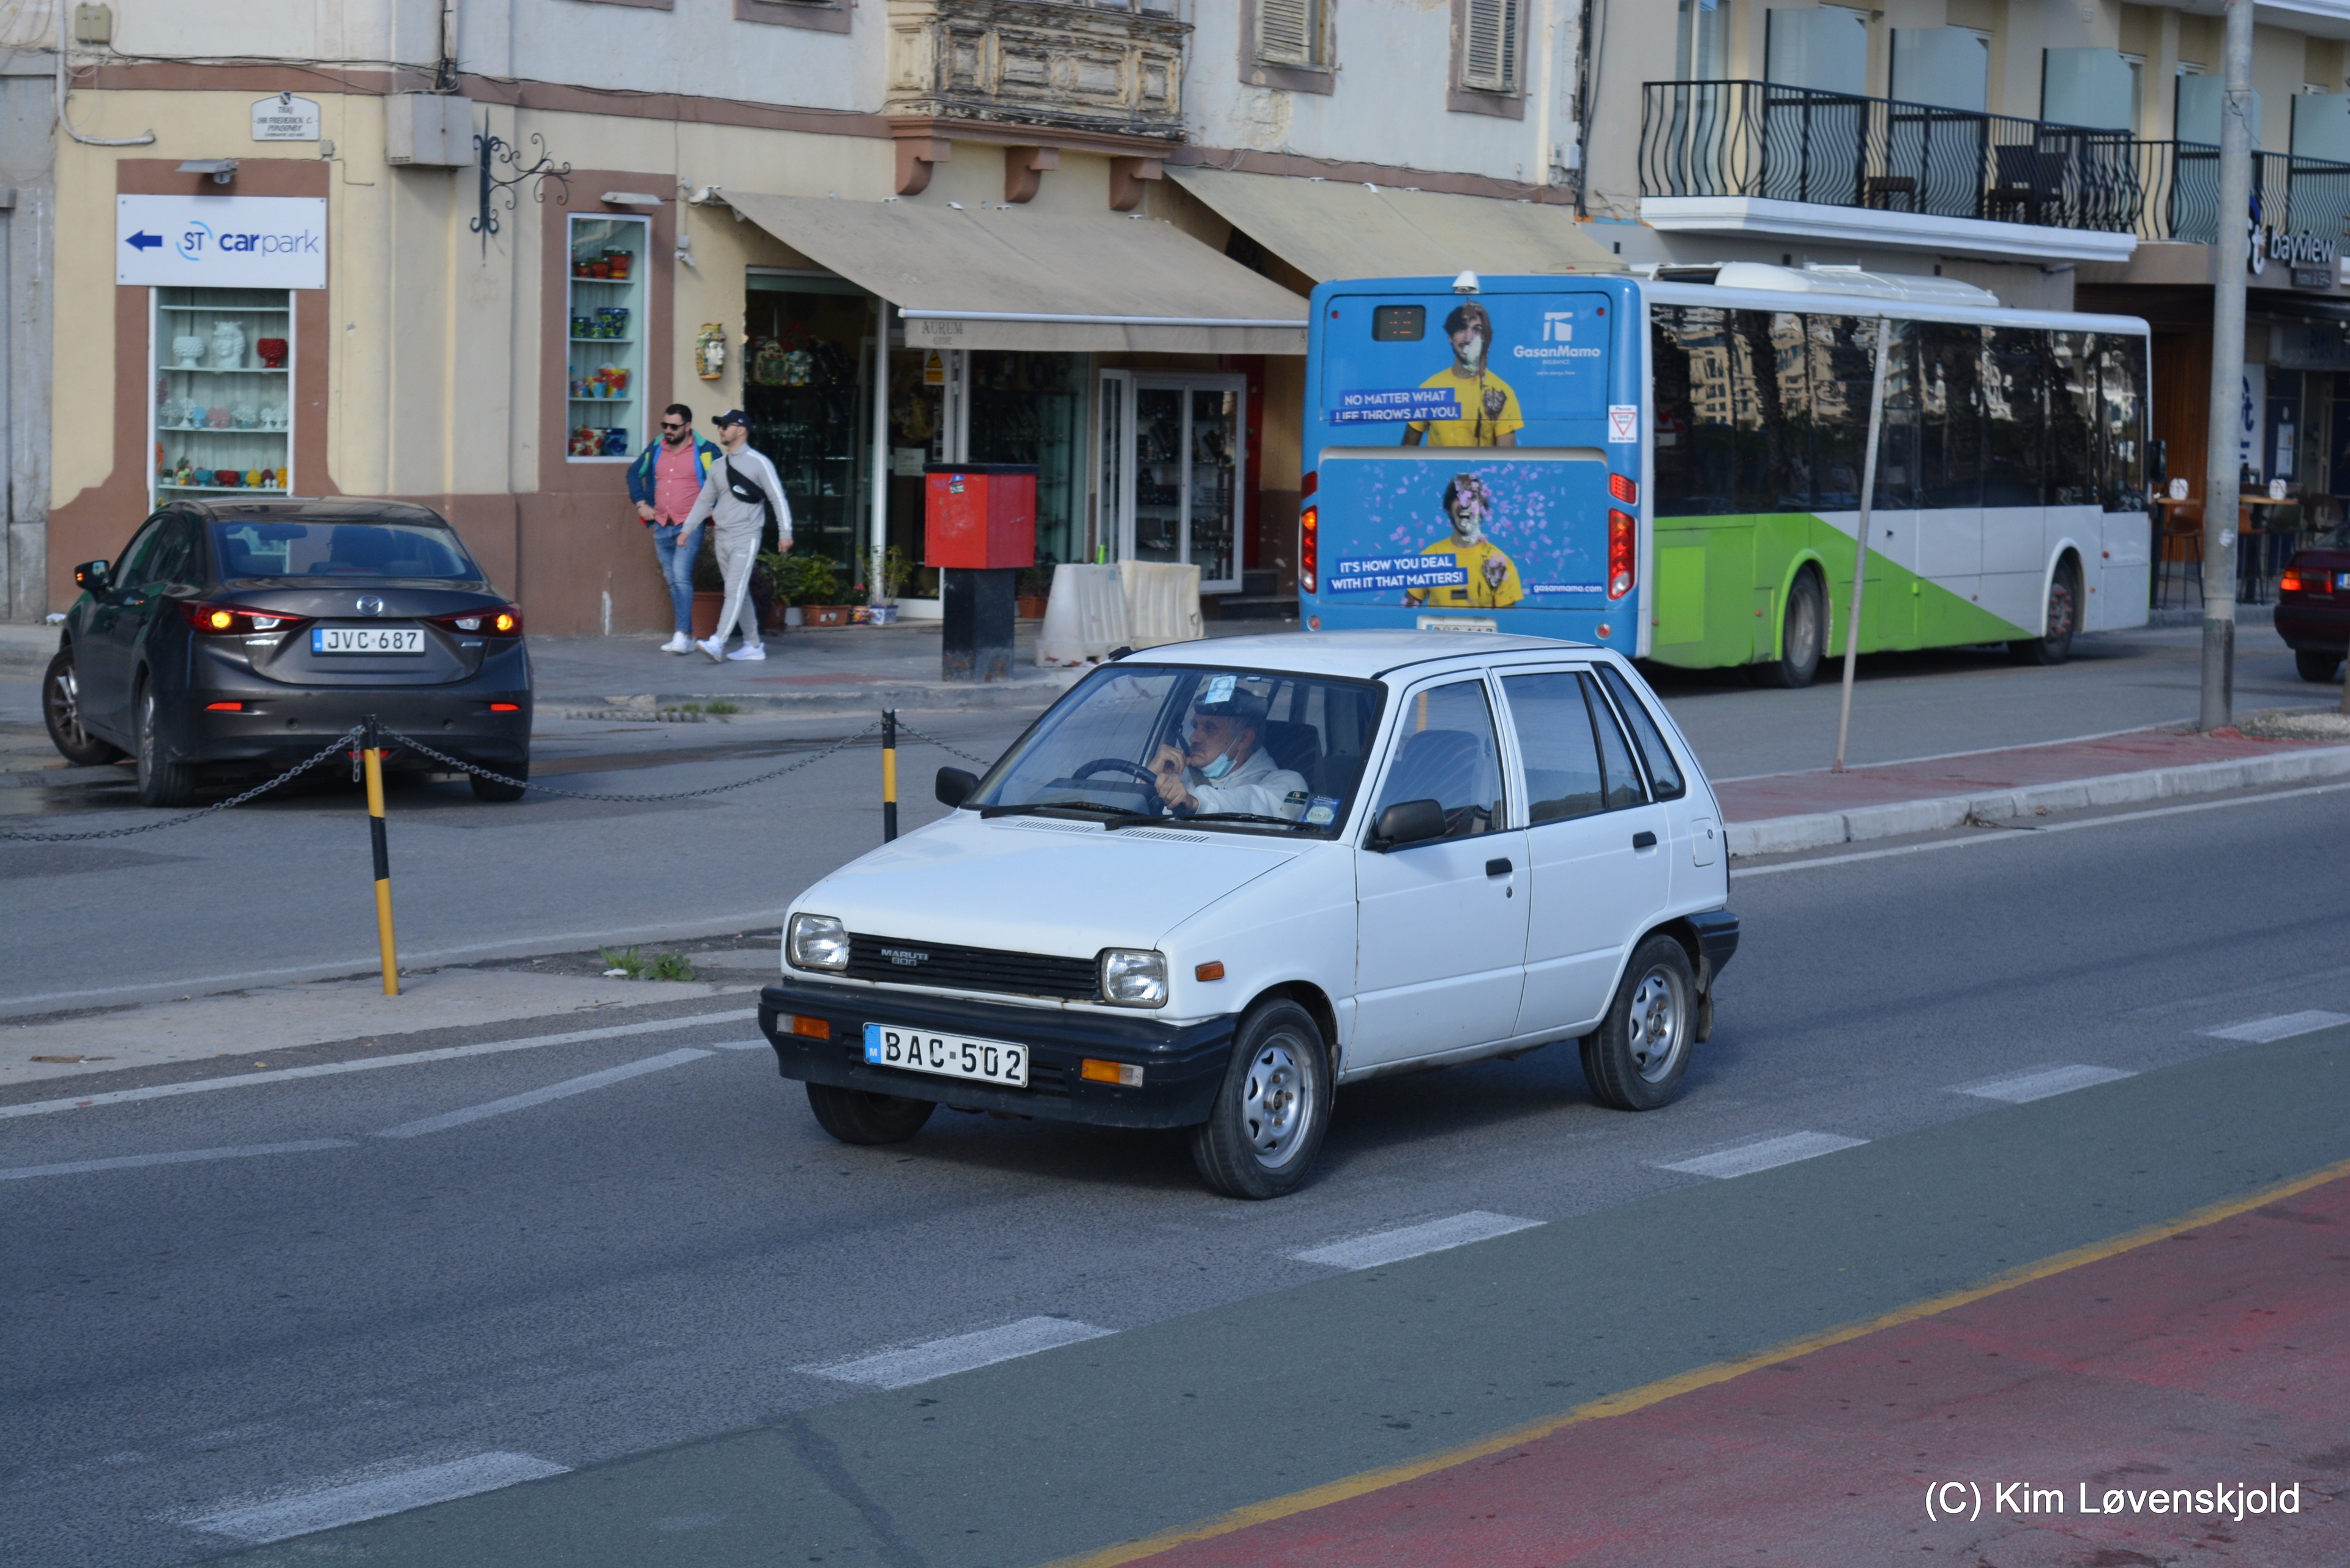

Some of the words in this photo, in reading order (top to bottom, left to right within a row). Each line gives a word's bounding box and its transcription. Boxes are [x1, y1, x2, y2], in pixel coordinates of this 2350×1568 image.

[184, 232, 205, 251] ST
[2270, 225, 2335, 268] bayview
[922, 321, 963, 335] AURUM
[1513, 345, 1601, 358] GasanMamo
[1345, 395, 1362, 405] NO
[1365, 392, 1409, 405] MATTER
[1412, 390, 1446, 403] WHAT
[1361, 408, 1410, 420] THROWS
[1413, 408, 1428, 419] AT
[1340, 561, 1360, 573] IT'S
[1362, 559, 1391, 572] HOW
[1393, 558, 1419, 570] YOU
[1421, 556, 1452, 568] DEAL
[1332, 577, 1361, 589] WITH
[1362, 577, 1373, 588] IT
[1375, 575, 1404, 587] THAT
[1407, 572, 1463, 586] MATTERS!
[881, 949, 928, 960] MARUTI
[892, 957, 917, 966] 800
[869, 1048, 878, 1057] M
